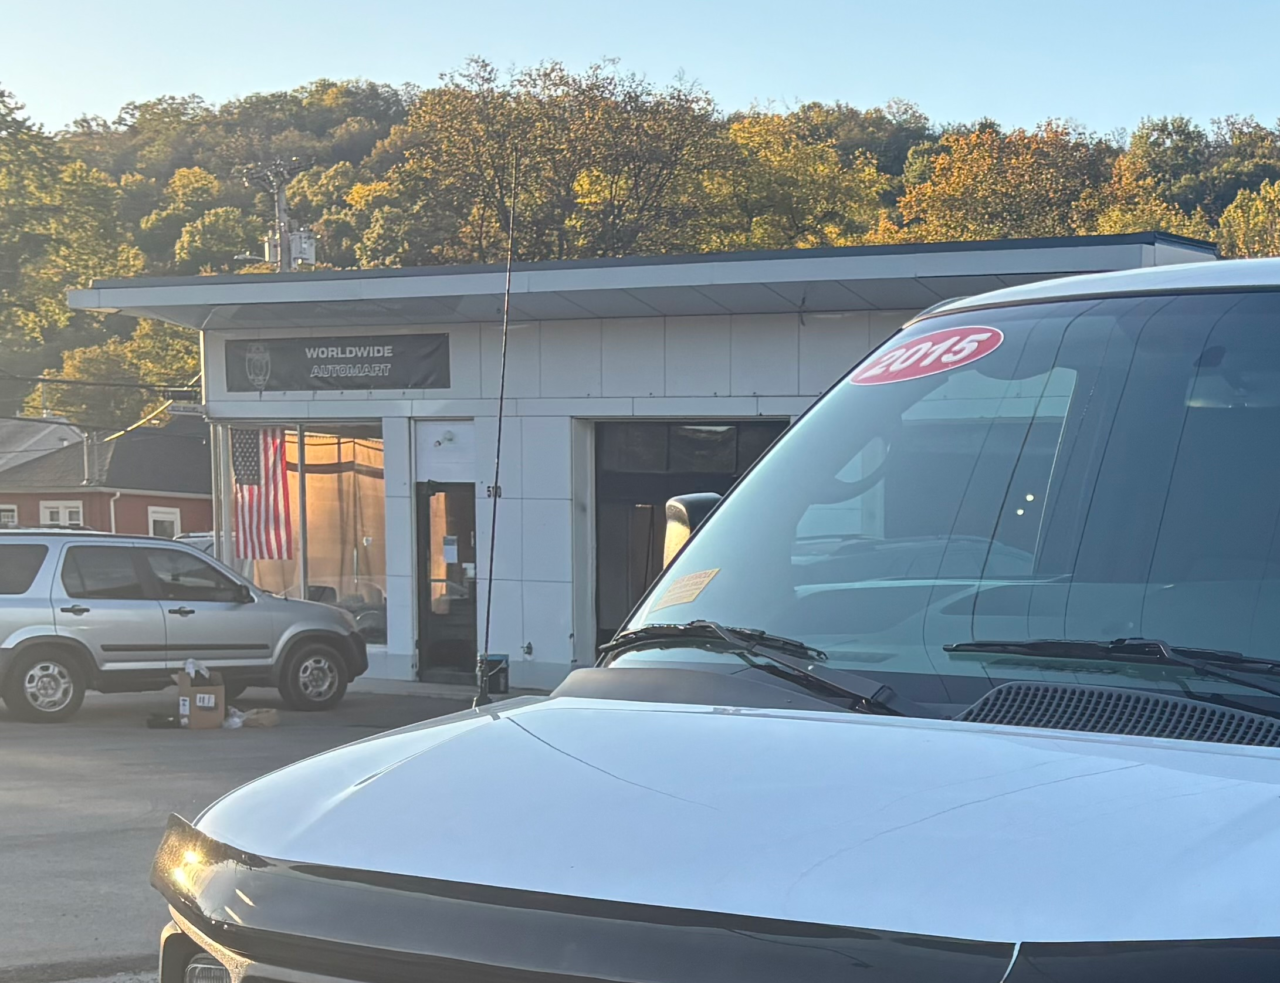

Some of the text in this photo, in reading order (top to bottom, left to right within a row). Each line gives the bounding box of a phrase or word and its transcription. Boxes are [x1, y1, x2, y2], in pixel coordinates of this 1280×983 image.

[305, 346, 393, 359] WORLDWIDE
[858, 332, 992, 380] 2015
[310, 364, 391, 377] AUTOMART
